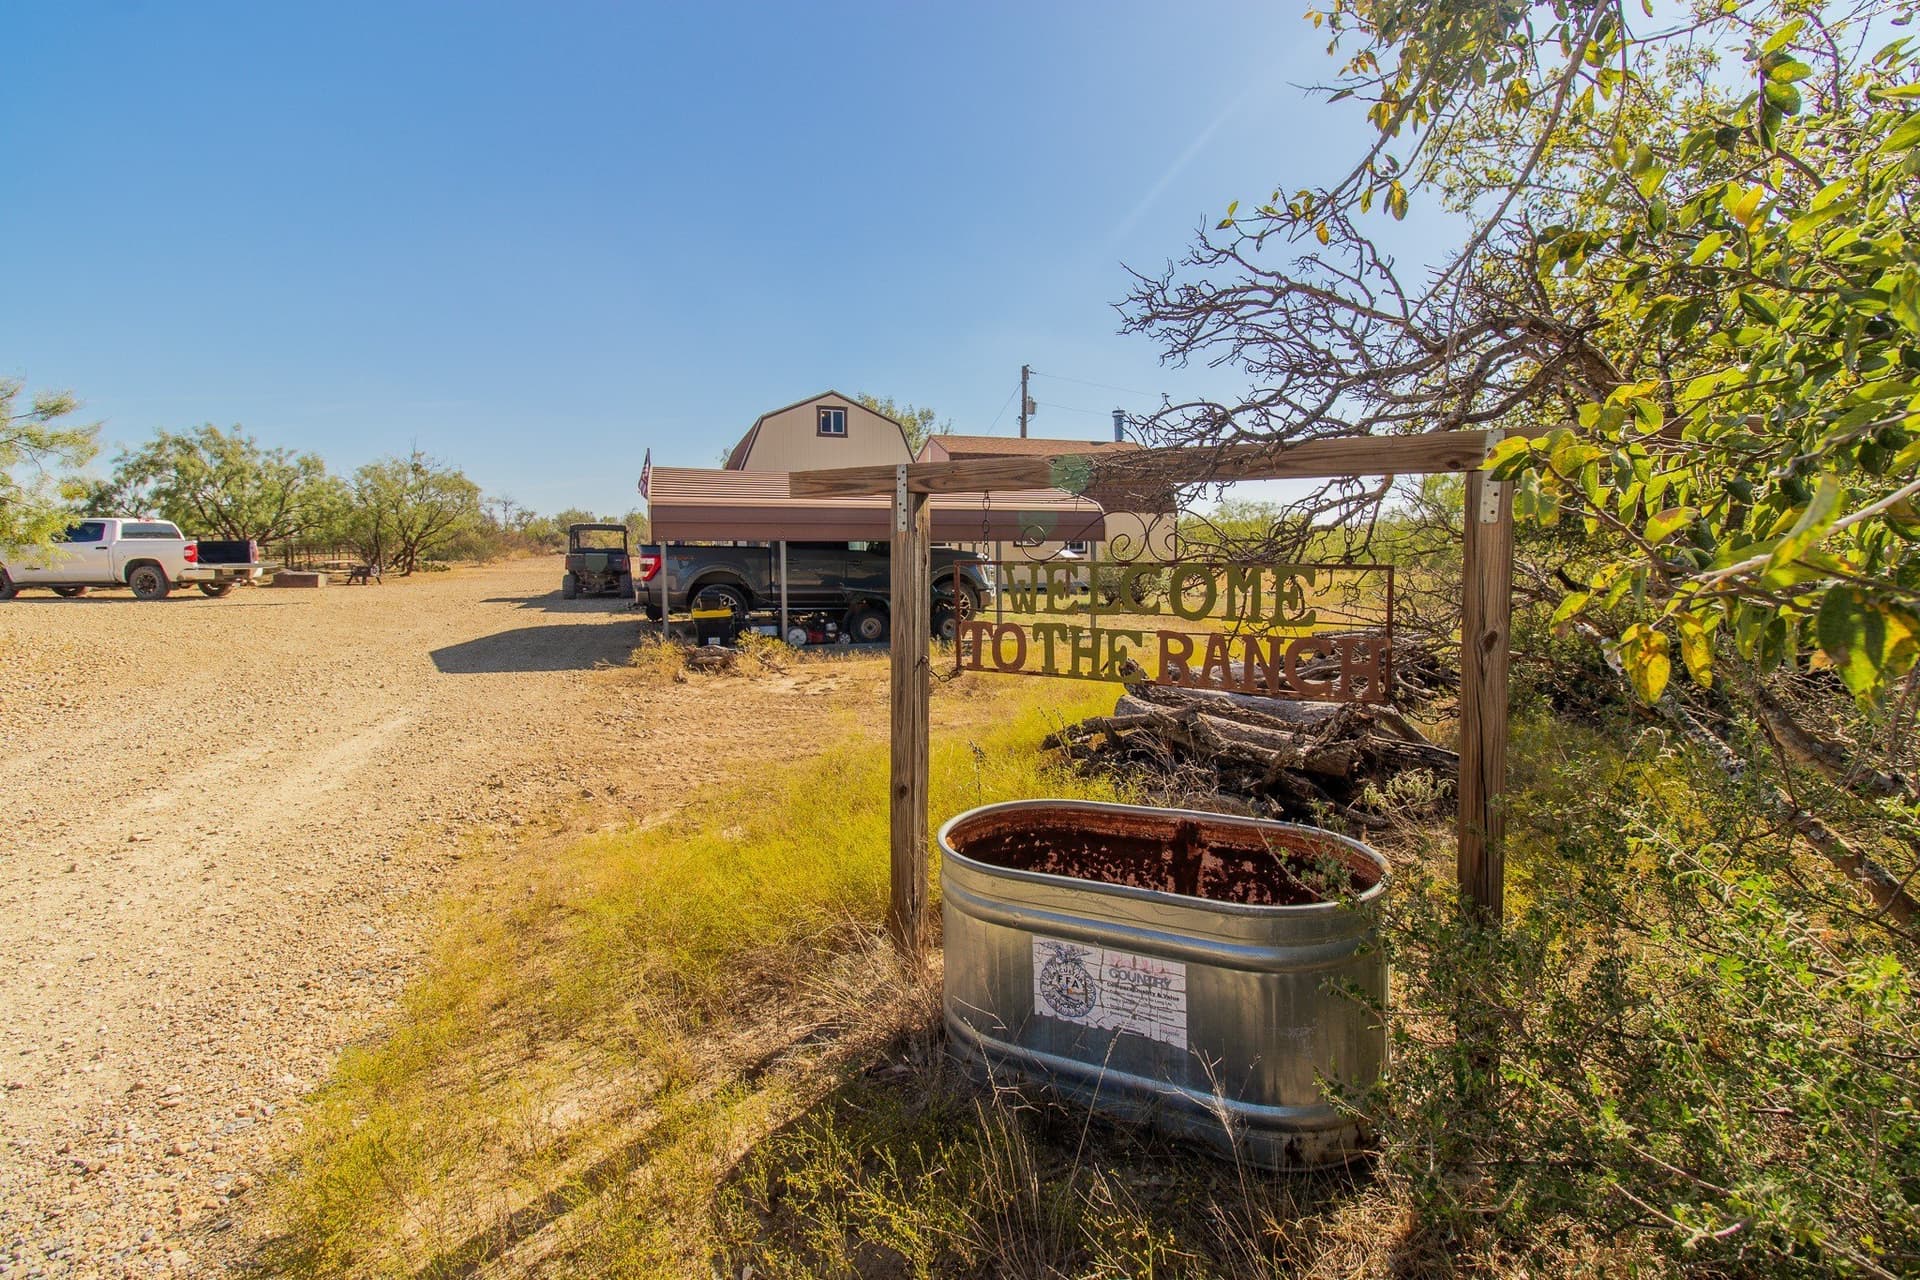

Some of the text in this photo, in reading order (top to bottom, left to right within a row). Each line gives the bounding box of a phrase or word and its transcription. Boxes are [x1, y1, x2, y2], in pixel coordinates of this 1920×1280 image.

[1002, 562, 1316, 627] WELCOME
[960, 620, 1393, 702] TO THE RANCH
[1058, 975, 1079, 989] FFA
